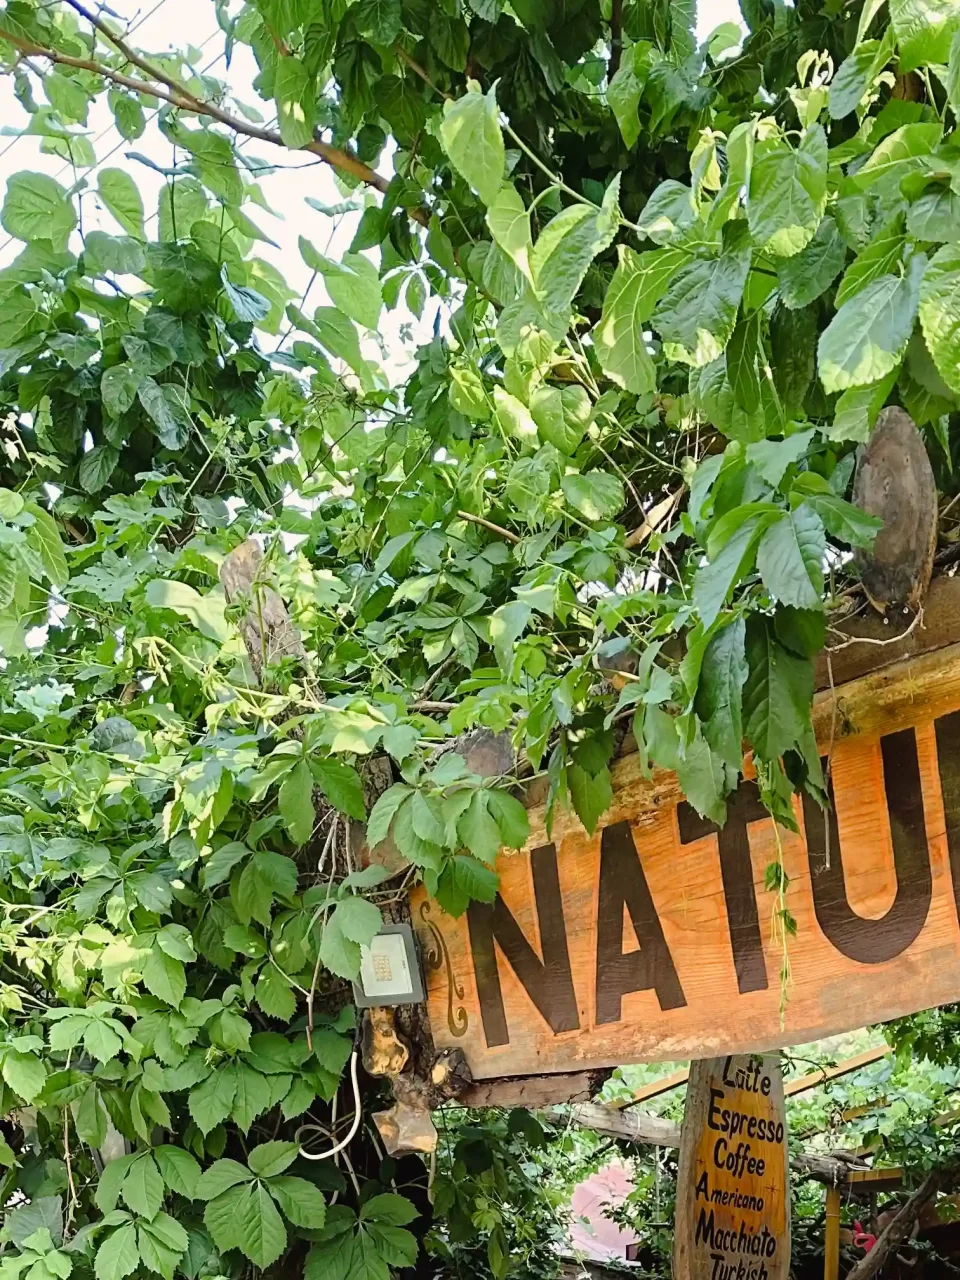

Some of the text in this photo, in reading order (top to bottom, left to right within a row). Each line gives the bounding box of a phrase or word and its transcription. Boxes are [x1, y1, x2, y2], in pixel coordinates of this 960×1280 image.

[722, 1055, 771, 1096] Latte
[707, 1088, 784, 1143] Espresso
[713, 1137, 765, 1180] Coffee
[695, 1171, 764, 1212] Americano
[695, 1207, 776, 1257] Macchiato
